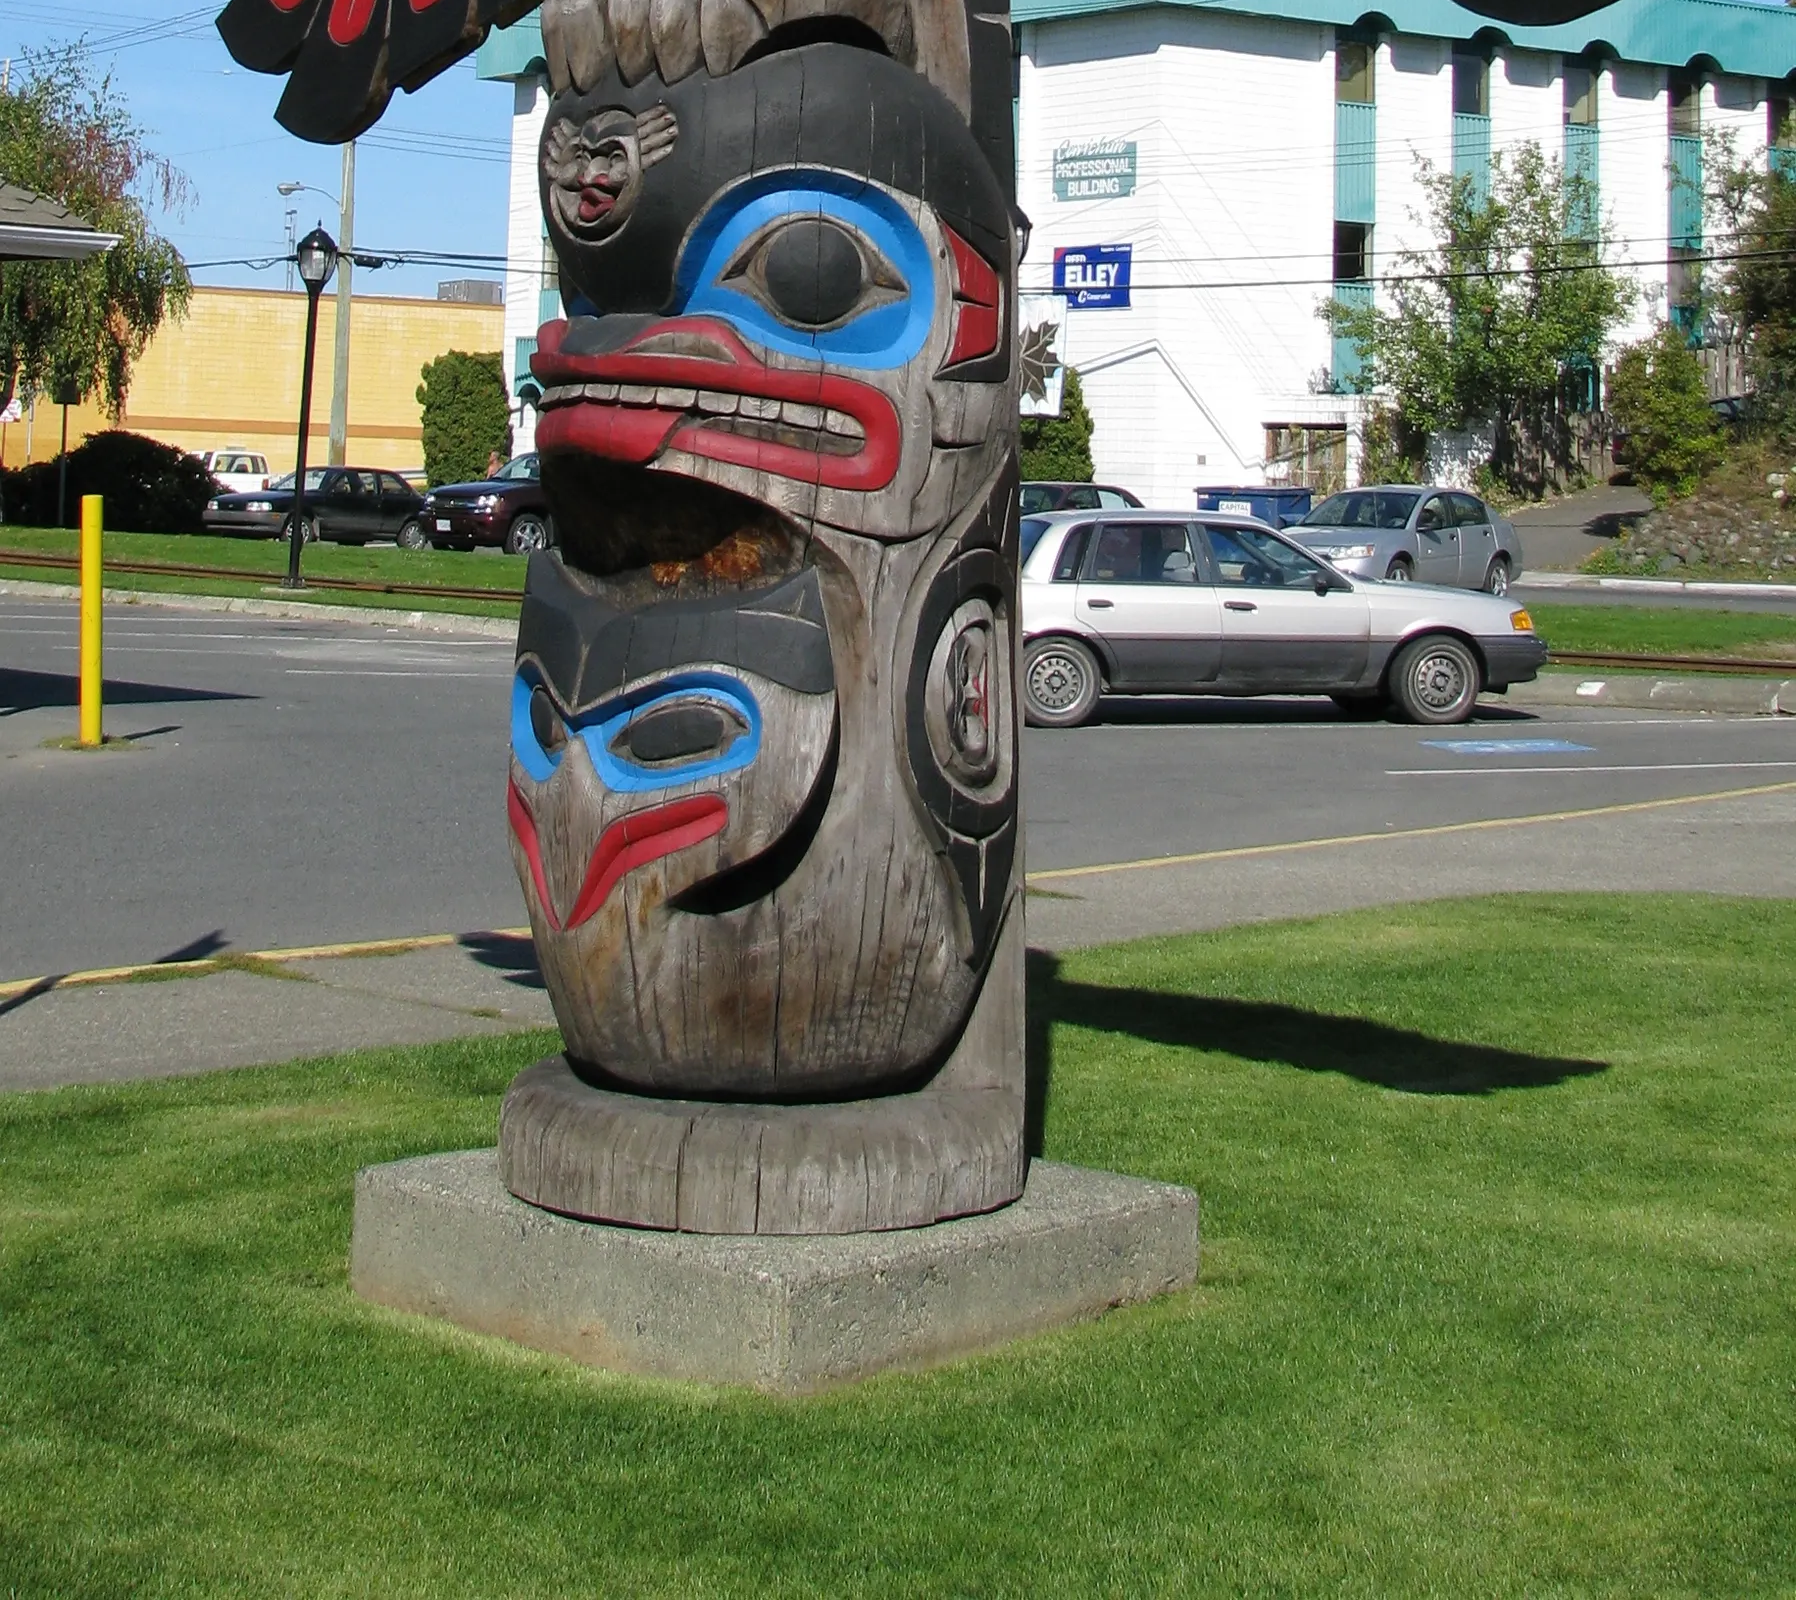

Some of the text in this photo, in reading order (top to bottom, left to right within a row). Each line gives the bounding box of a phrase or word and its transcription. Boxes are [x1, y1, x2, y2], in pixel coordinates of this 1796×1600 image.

[1055, 157, 1132, 178] PROFESSIONAL
[1067, 177, 1120, 196] BUILDING
[1065, 263, 1119, 288] ELLEY
[1220, 503, 1248, 511] CAPITAL
